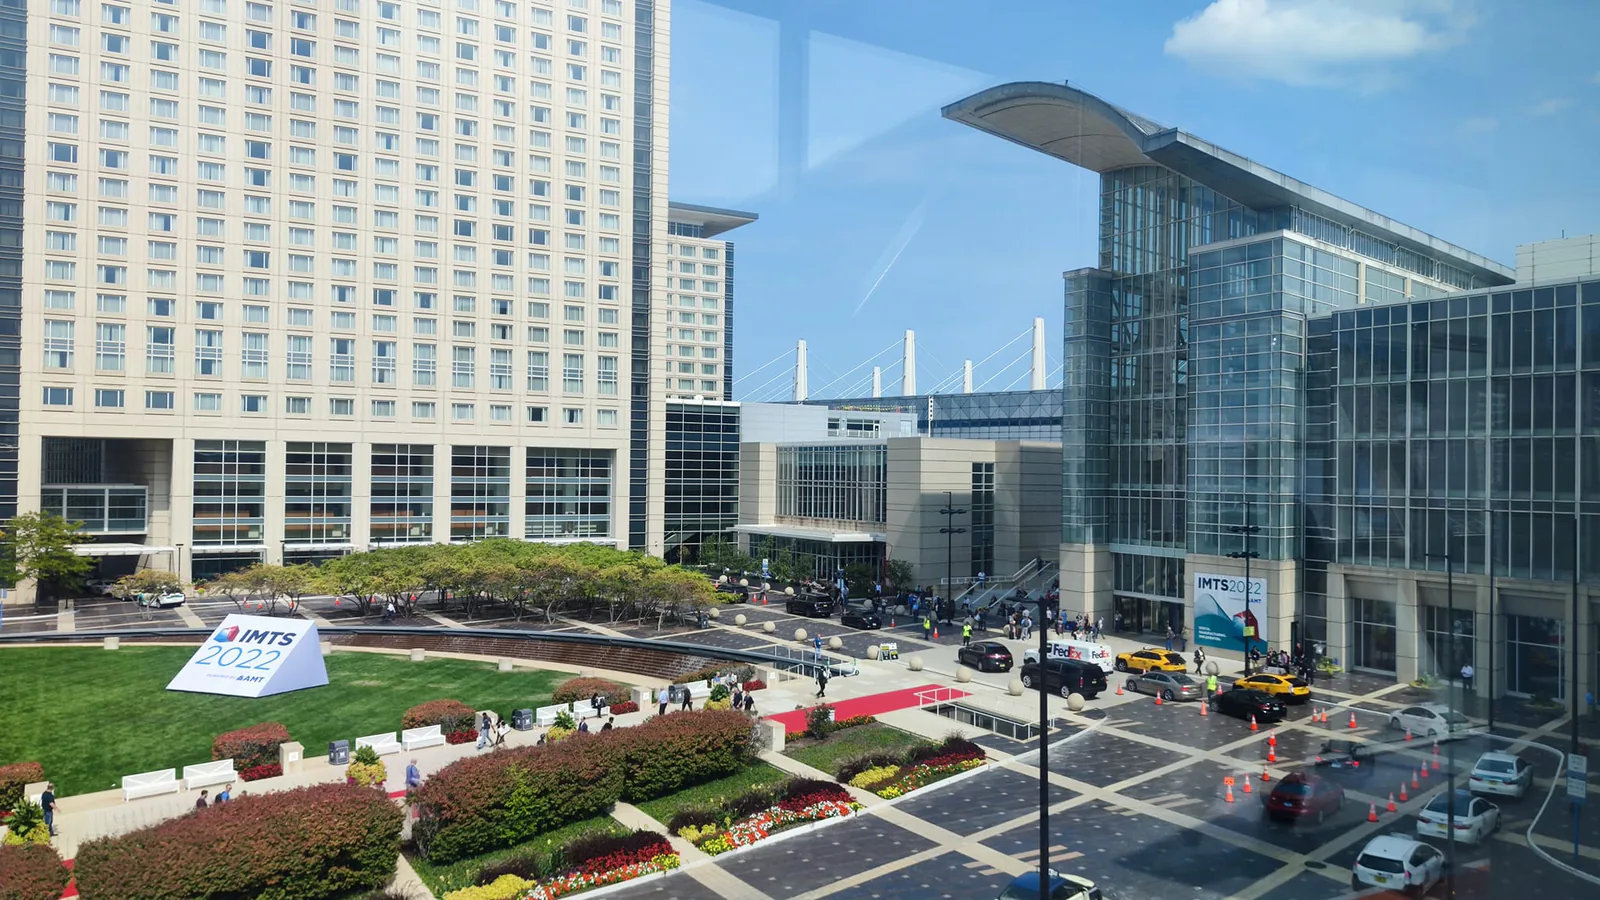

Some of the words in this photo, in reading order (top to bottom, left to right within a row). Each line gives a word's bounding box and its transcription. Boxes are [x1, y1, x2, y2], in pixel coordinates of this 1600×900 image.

[239, 629, 296, 646] IMTS
[195, 645, 280, 670] 2022
[1053, 644, 1082, 659] FedEx
[1092, 650, 1109, 659] FedEx
